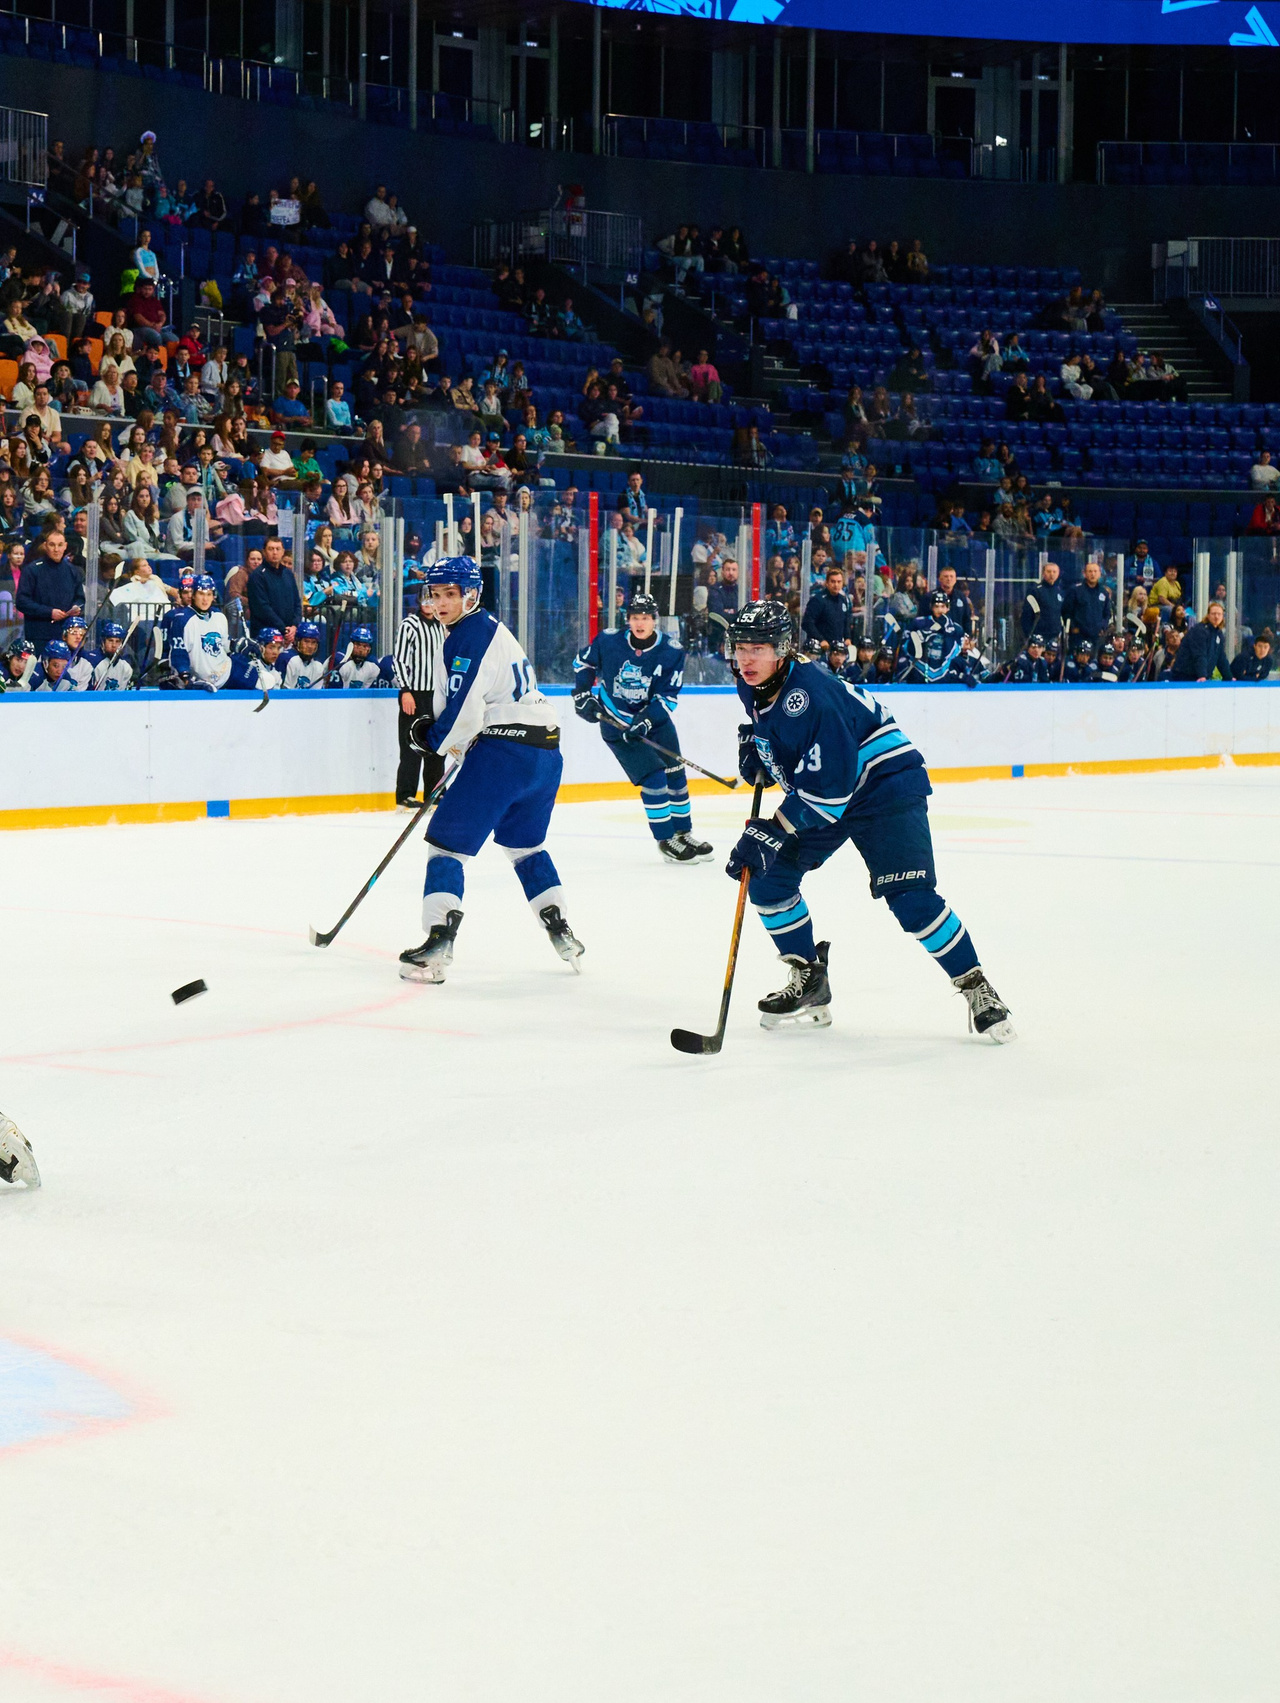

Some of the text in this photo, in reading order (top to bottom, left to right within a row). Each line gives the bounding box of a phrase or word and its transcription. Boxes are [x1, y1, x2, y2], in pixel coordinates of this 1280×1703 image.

[833, 521, 856, 542] 85
[740, 613, 756, 623] 53
[653, 664, 662, 676] A
[744, 826, 783, 852] BAUE
